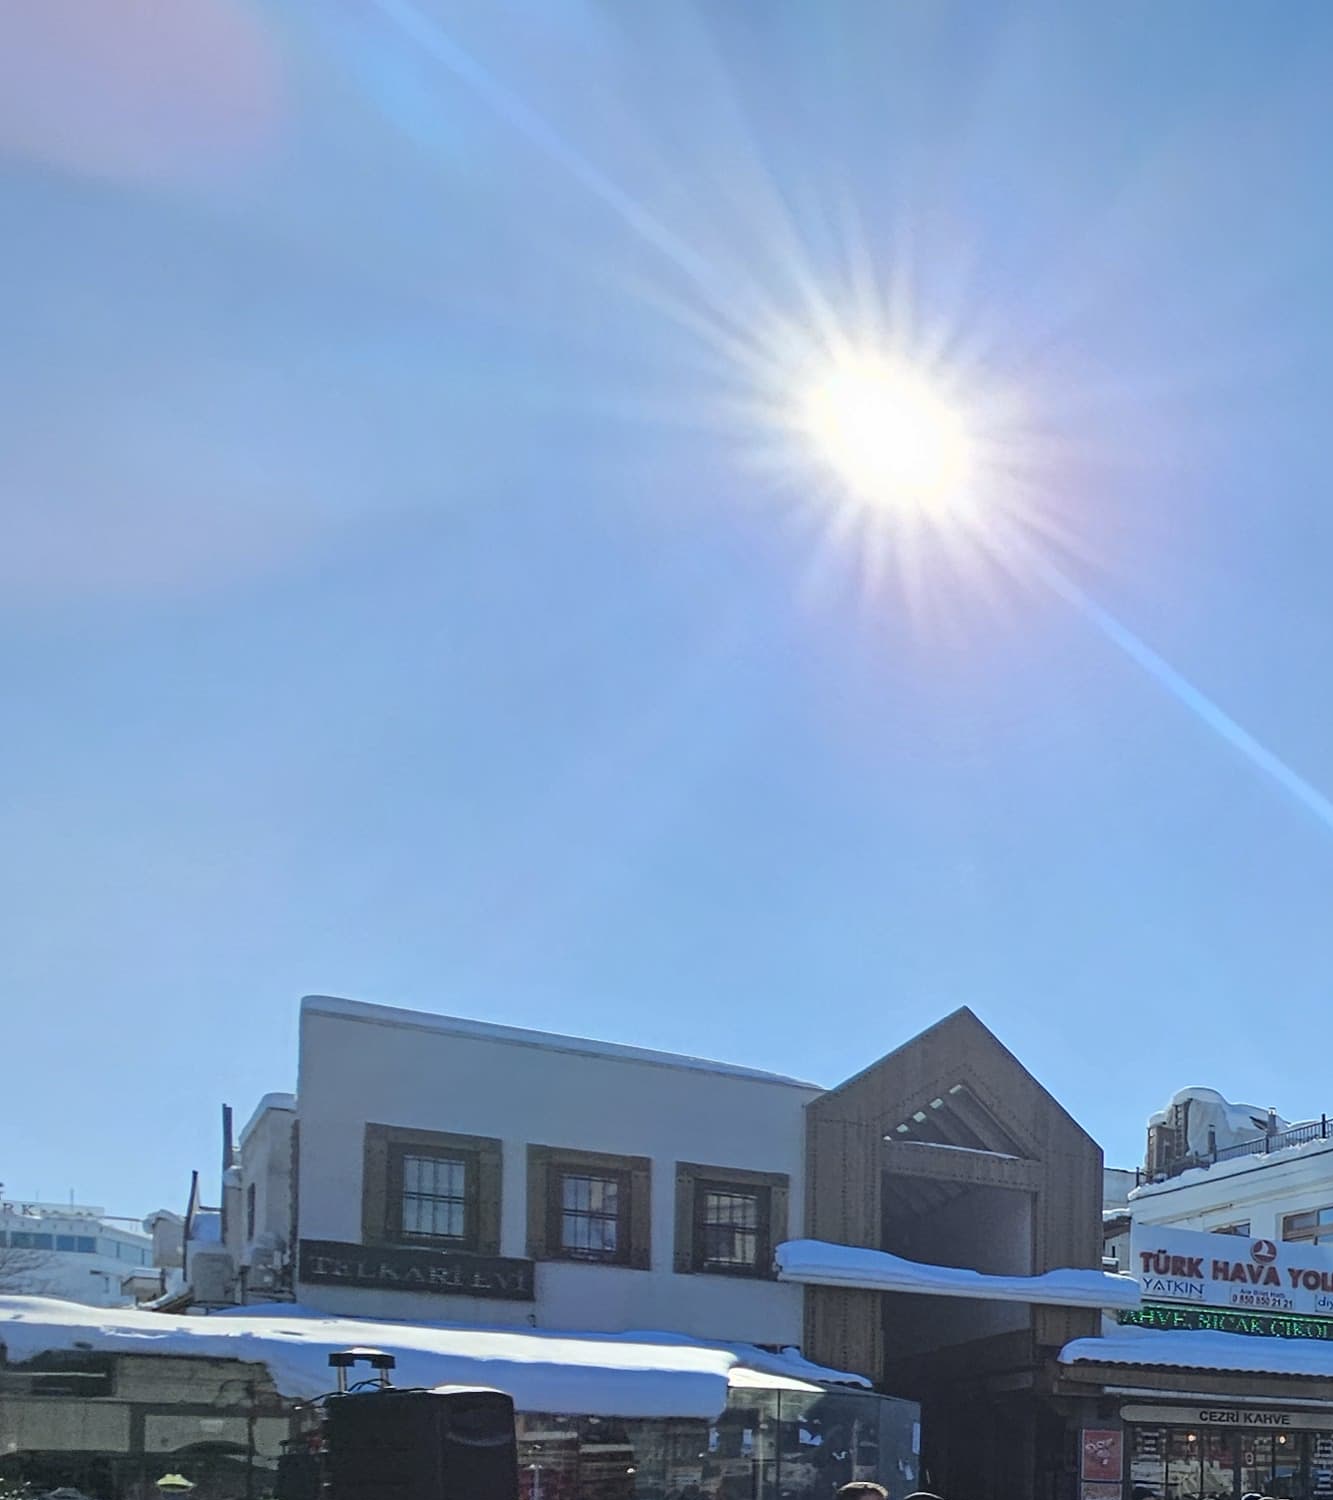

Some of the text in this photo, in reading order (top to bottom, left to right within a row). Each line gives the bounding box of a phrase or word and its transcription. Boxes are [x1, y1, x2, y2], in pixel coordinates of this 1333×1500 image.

[1140, 1249, 1205, 1280] TÜRK
[1212, 1259, 1281, 1287] HAVA
[1143, 1278, 1205, 1295] YATKIN
[1244, 1412, 1291, 1425] KAHVE
